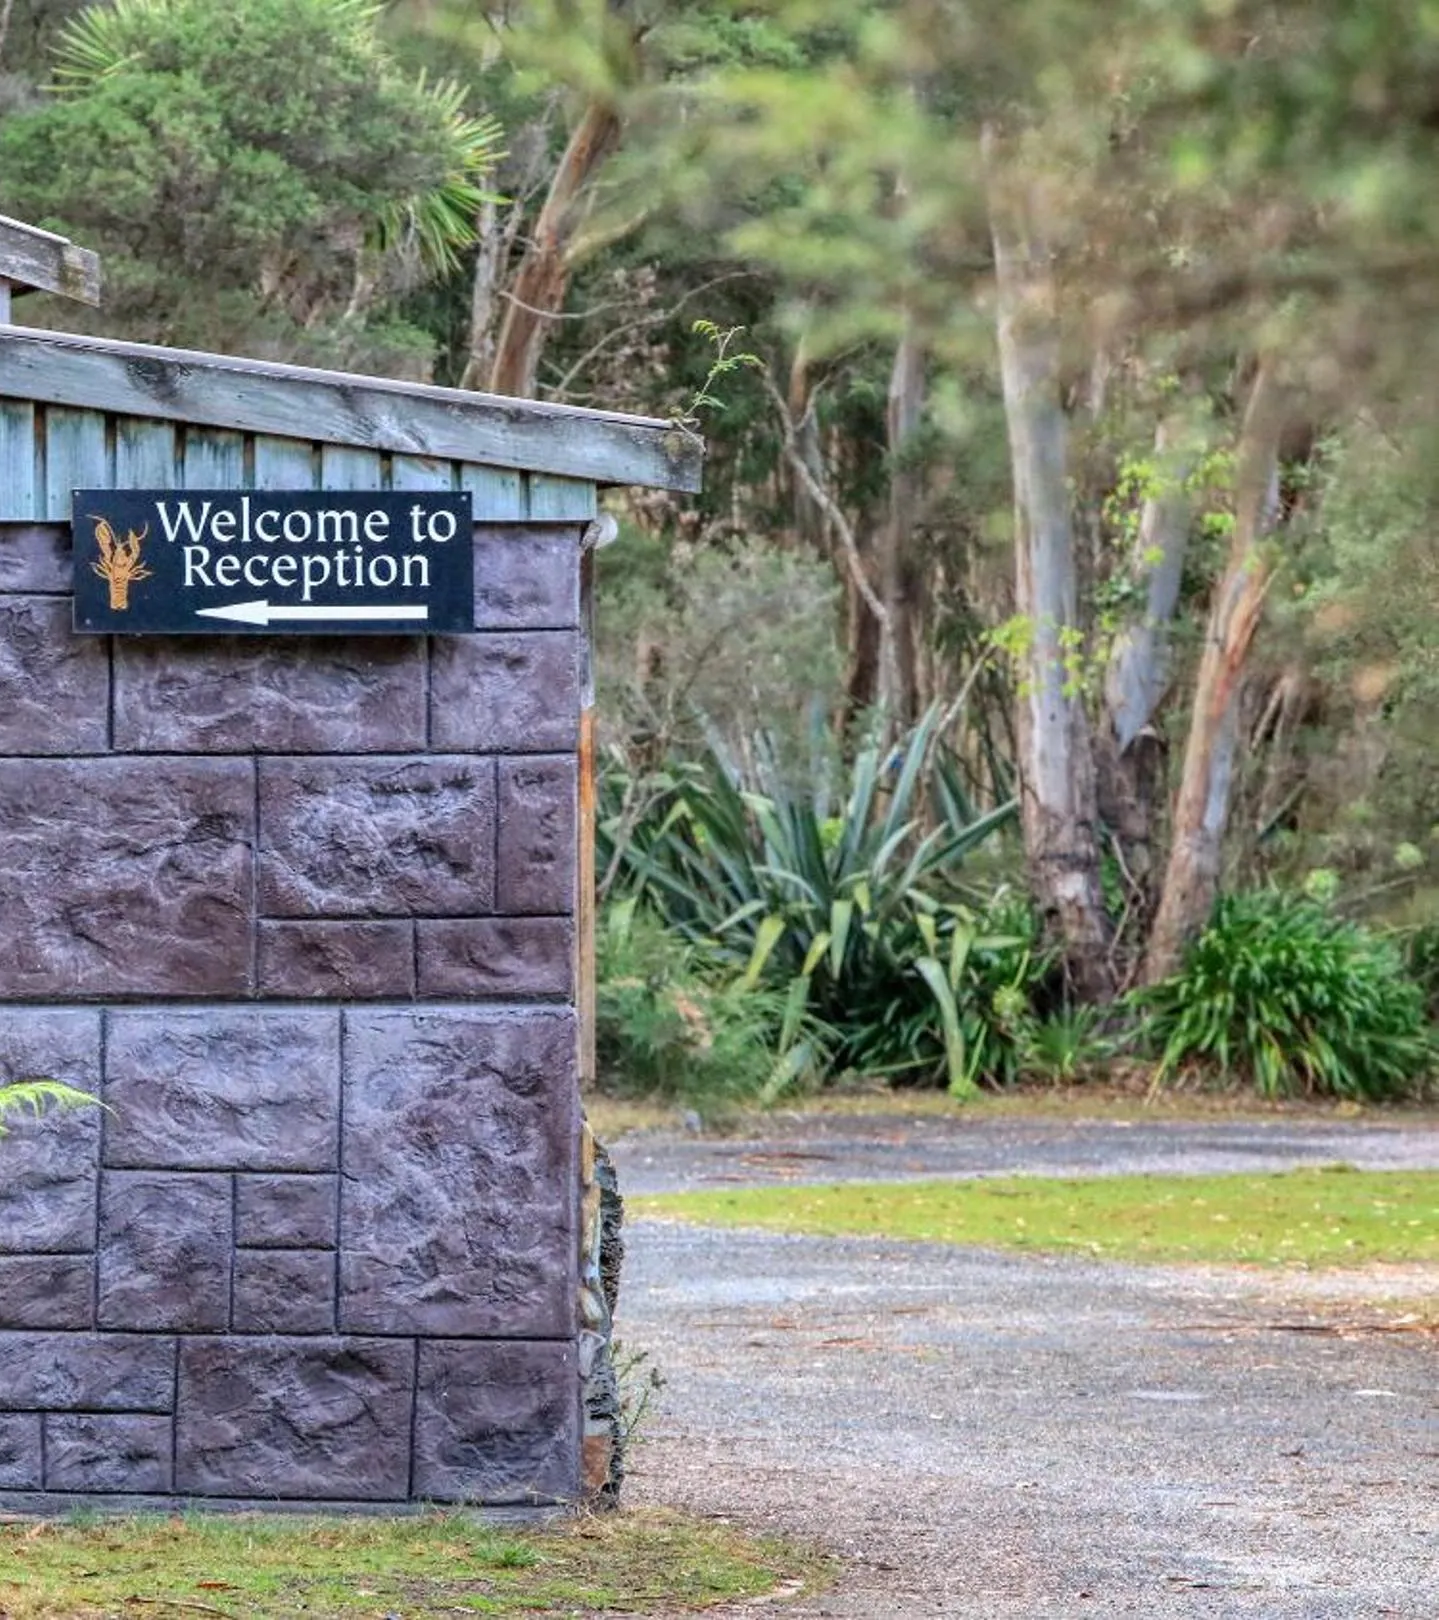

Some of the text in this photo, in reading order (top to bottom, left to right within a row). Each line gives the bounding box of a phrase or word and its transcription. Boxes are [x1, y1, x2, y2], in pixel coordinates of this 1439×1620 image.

[155, 496, 457, 543] Welcome to
[183, 544, 430, 601] Reception
